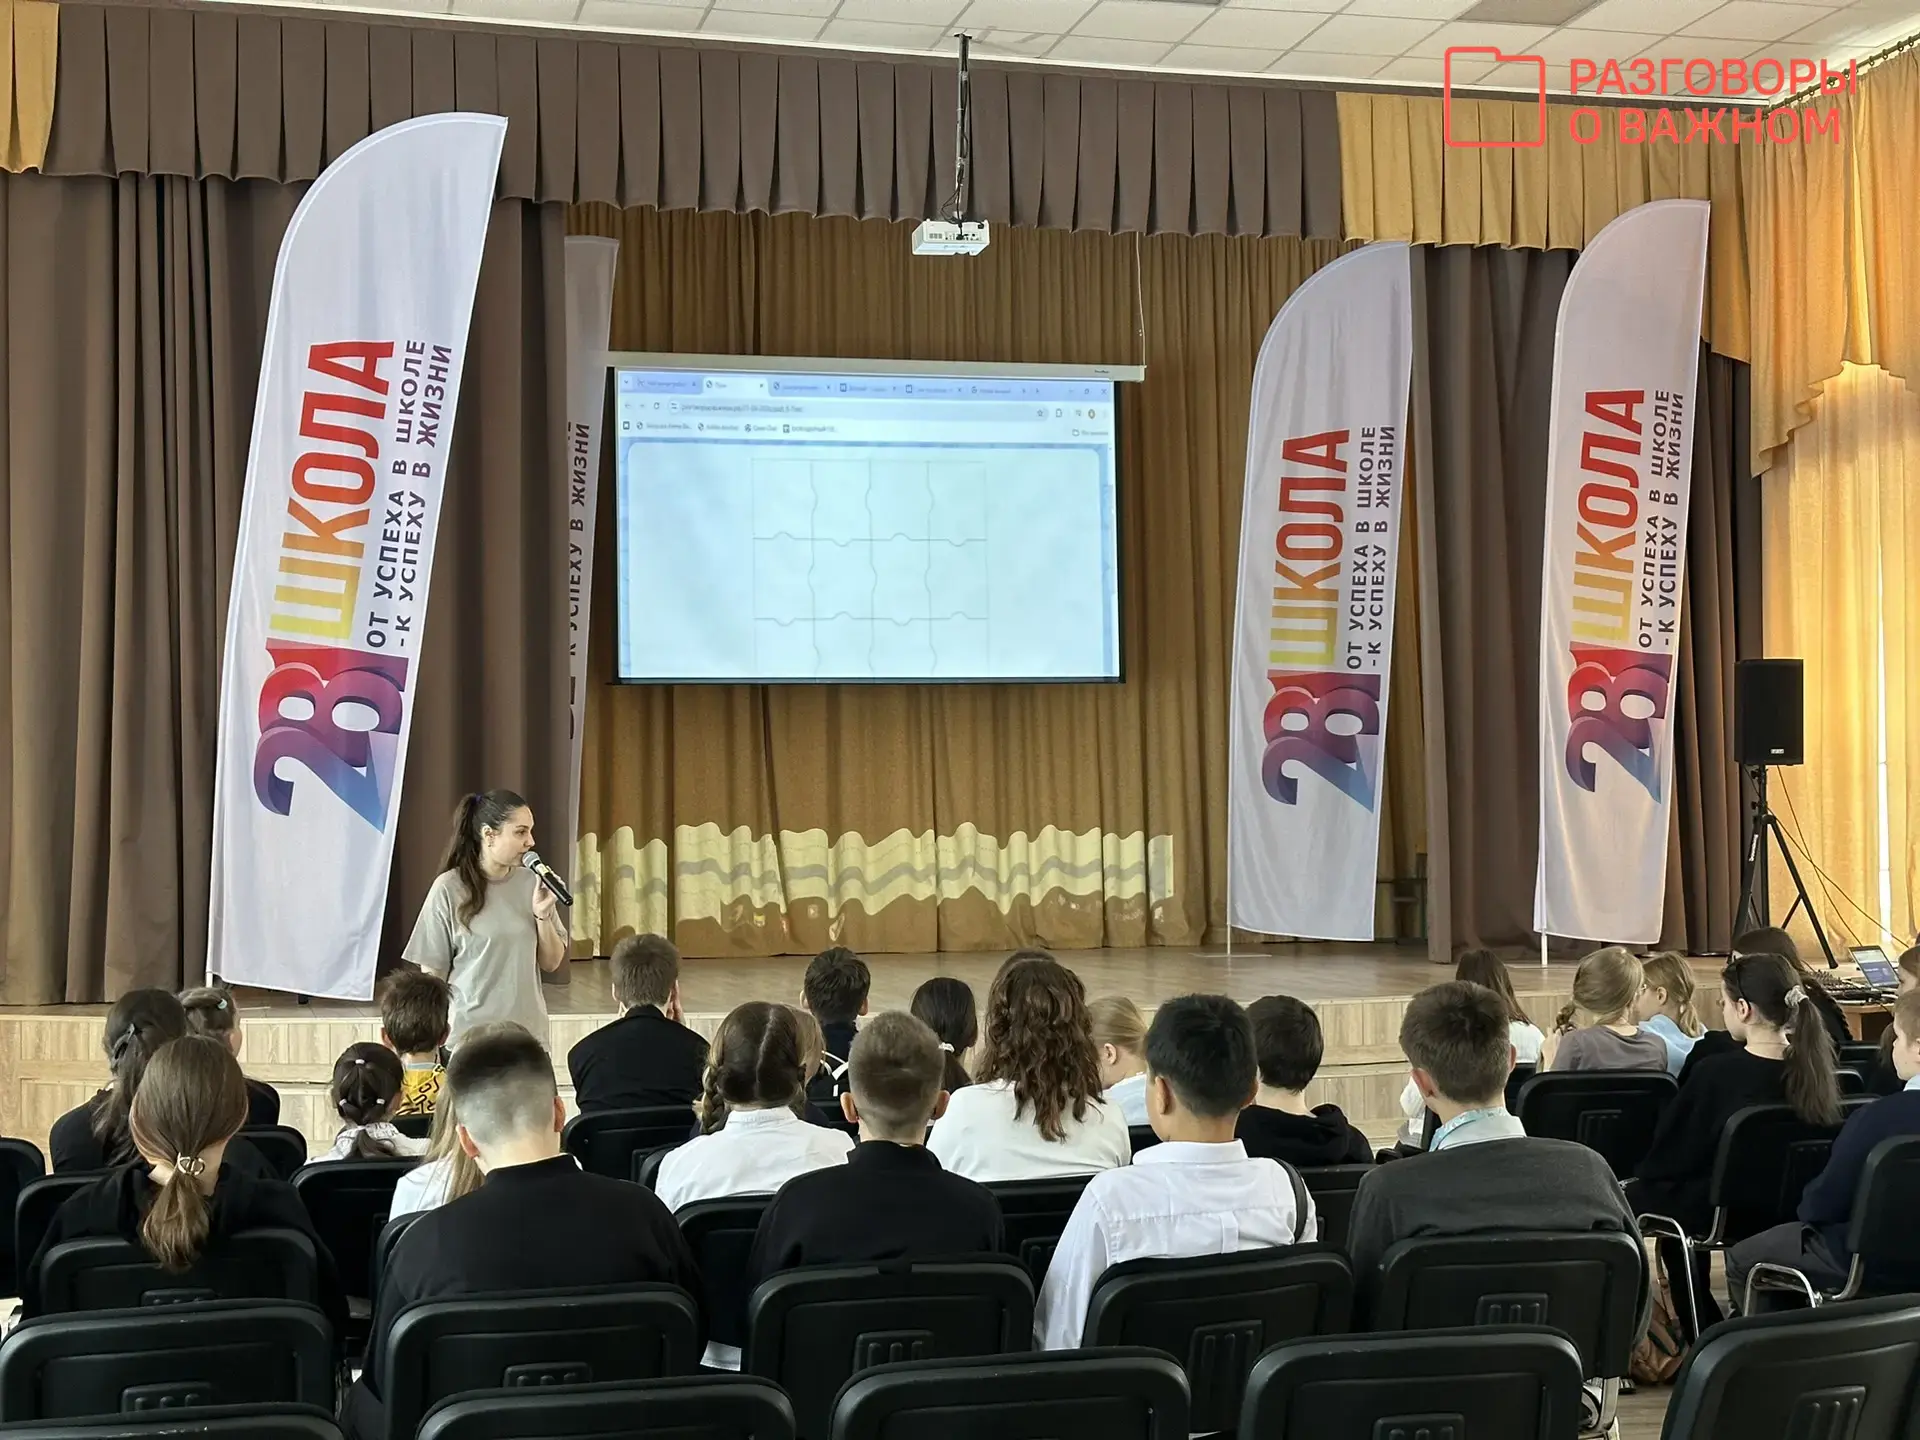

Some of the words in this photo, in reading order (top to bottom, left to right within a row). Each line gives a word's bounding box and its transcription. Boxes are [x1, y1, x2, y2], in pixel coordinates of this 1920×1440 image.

[396, 340, 426, 443] ШКОЛЕ
[416, 344, 452, 448] ЖИЗНИ
[1651, 390, 1670, 476] ШКОЛЕ
[392, 459, 407, 475] В
[412, 461, 431, 478] В
[571, 423, 590, 507] ЖИЗНИ
[1357, 427, 1376, 508] ШКОЛЕ
[1375, 426, 1395, 508] ЖИЗНИ
[1665, 393, 1684, 480] ЖИЗНИ
[269, 341, 395, 640] ШКОЛА
[570, 518, 584, 532] В
[1355, 521, 1370, 533] В
[1374, 520, 1388, 533] В
[1571, 389, 1645, 641] ШКОЛА
[1648, 489, 1661, 503] В
[1663, 492, 1678, 505] В
[373, 490, 405, 599] УСПЕХА
[399, 491, 426, 601] УСПЕХУ
[1269, 429, 1350, 665] ШКОЛА
[1349, 544, 1369, 631] УСПЕХА
[1368, 544, 1387, 631] УСПЕХУ
[1641, 515, 1659, 606] УСПЕХА
[1659, 517, 1678, 608] УСПЕХУ
[366, 611, 389, 648] ОТ
[1346, 641, 1362, 669] ОТ
[1638, 617, 1652, 648] ОТ
[253, 637, 409, 834] 281
[1262, 669, 1381, 814] 281
[1565, 641, 1673, 804] 281
